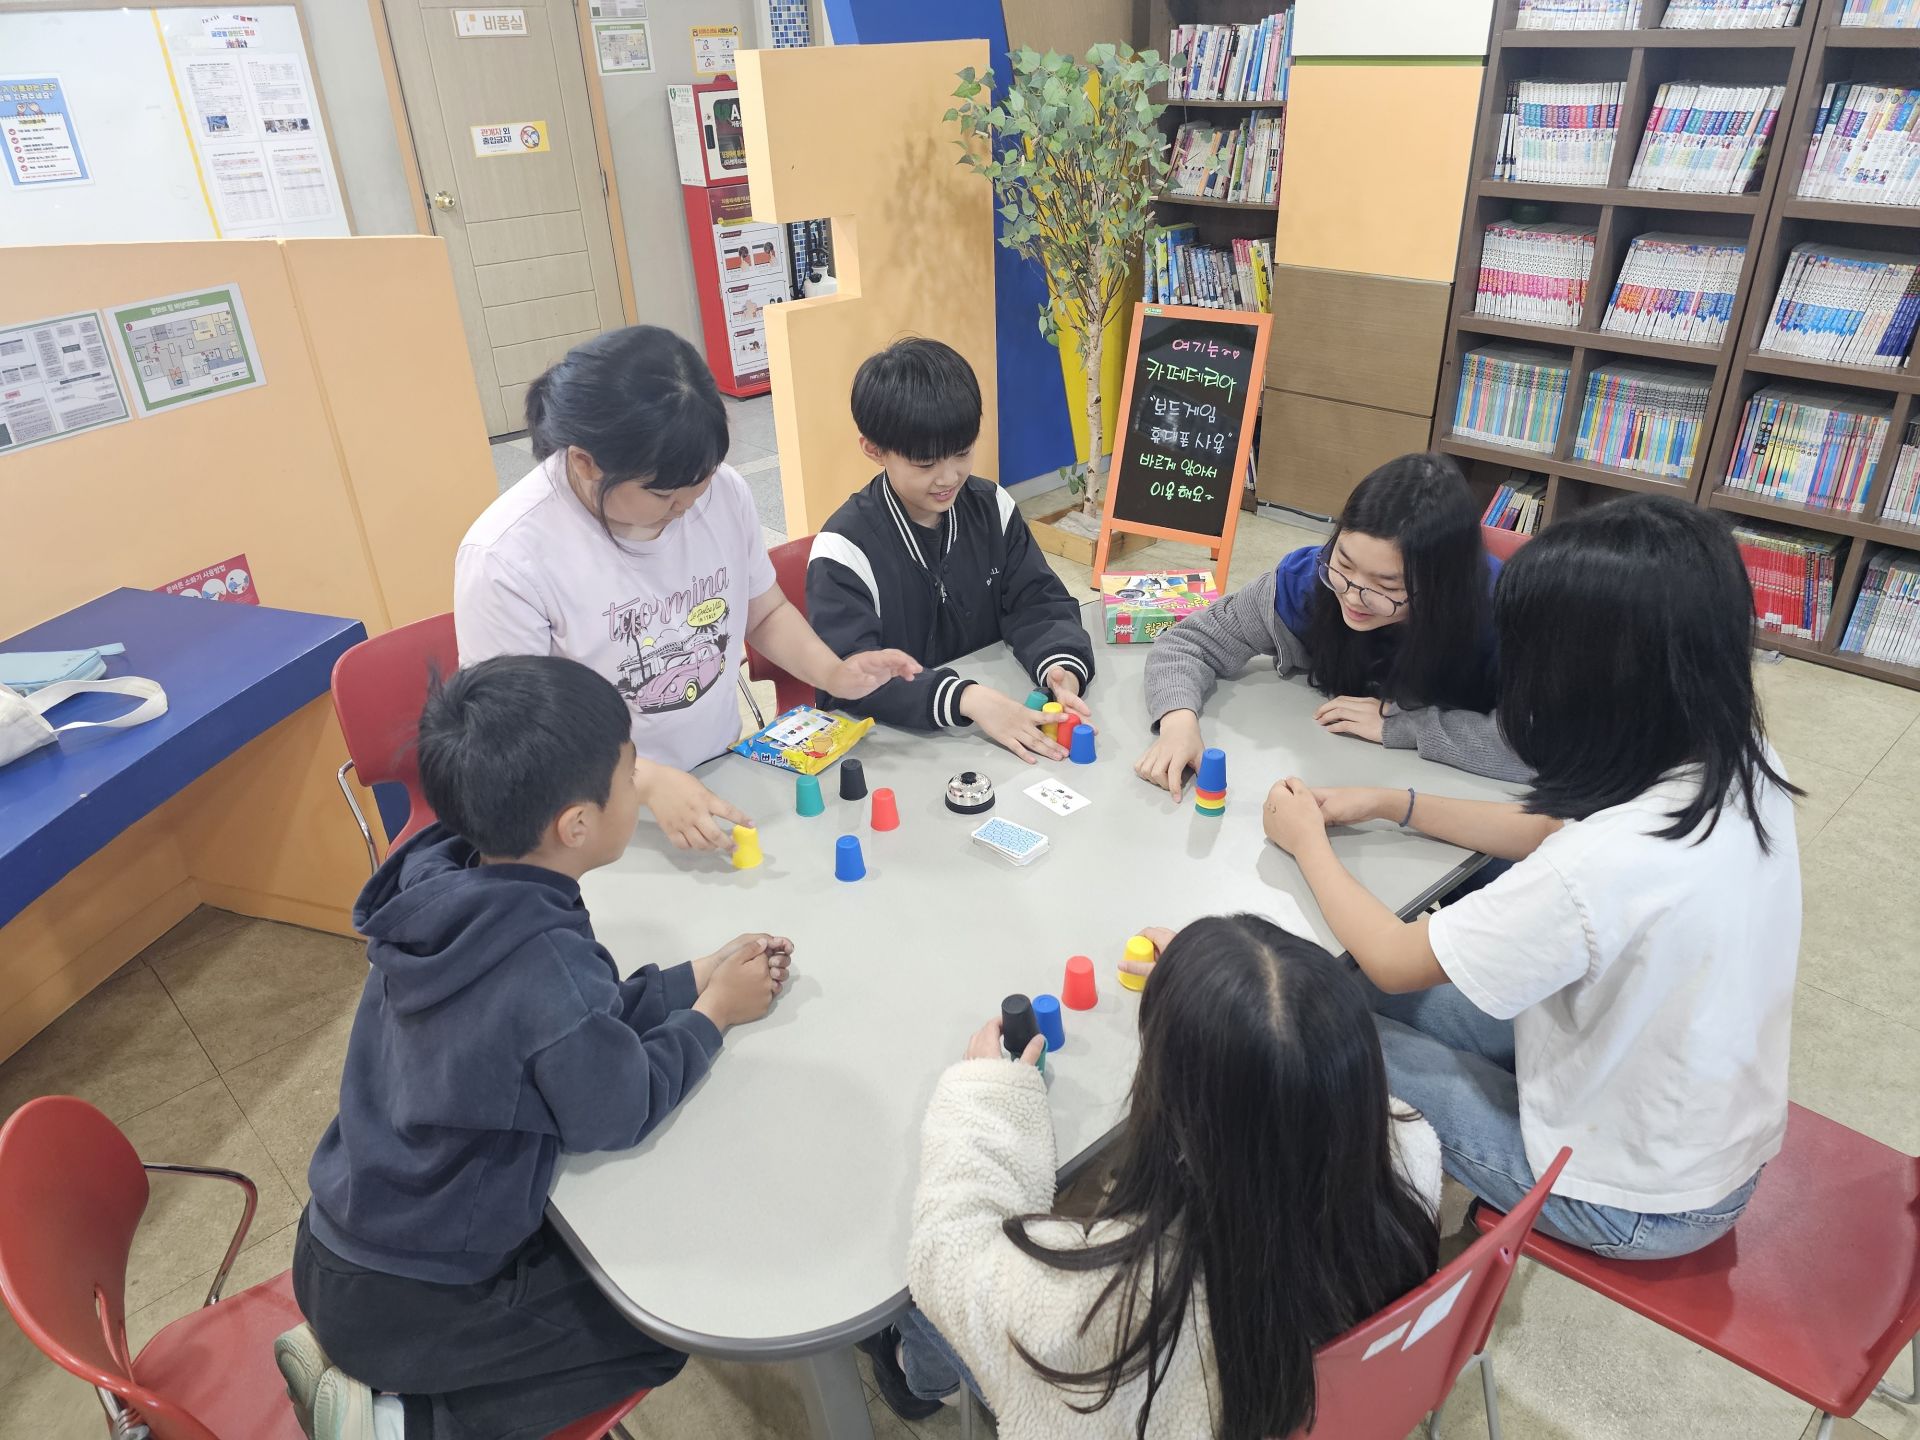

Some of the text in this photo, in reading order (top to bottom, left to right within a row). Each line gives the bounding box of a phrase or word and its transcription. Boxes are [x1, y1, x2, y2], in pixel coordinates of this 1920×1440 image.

[482, 15, 523, 31] 비품실
[481, 127, 511, 137] 관계자 외
[1147, 358, 1237, 403] 카페테리아
[1150, 427, 1190, 447] 휴대폰
[1140, 453, 1176, 471] 바르게
[166, 564, 226, 594] 올바른 소화기 사용방법
